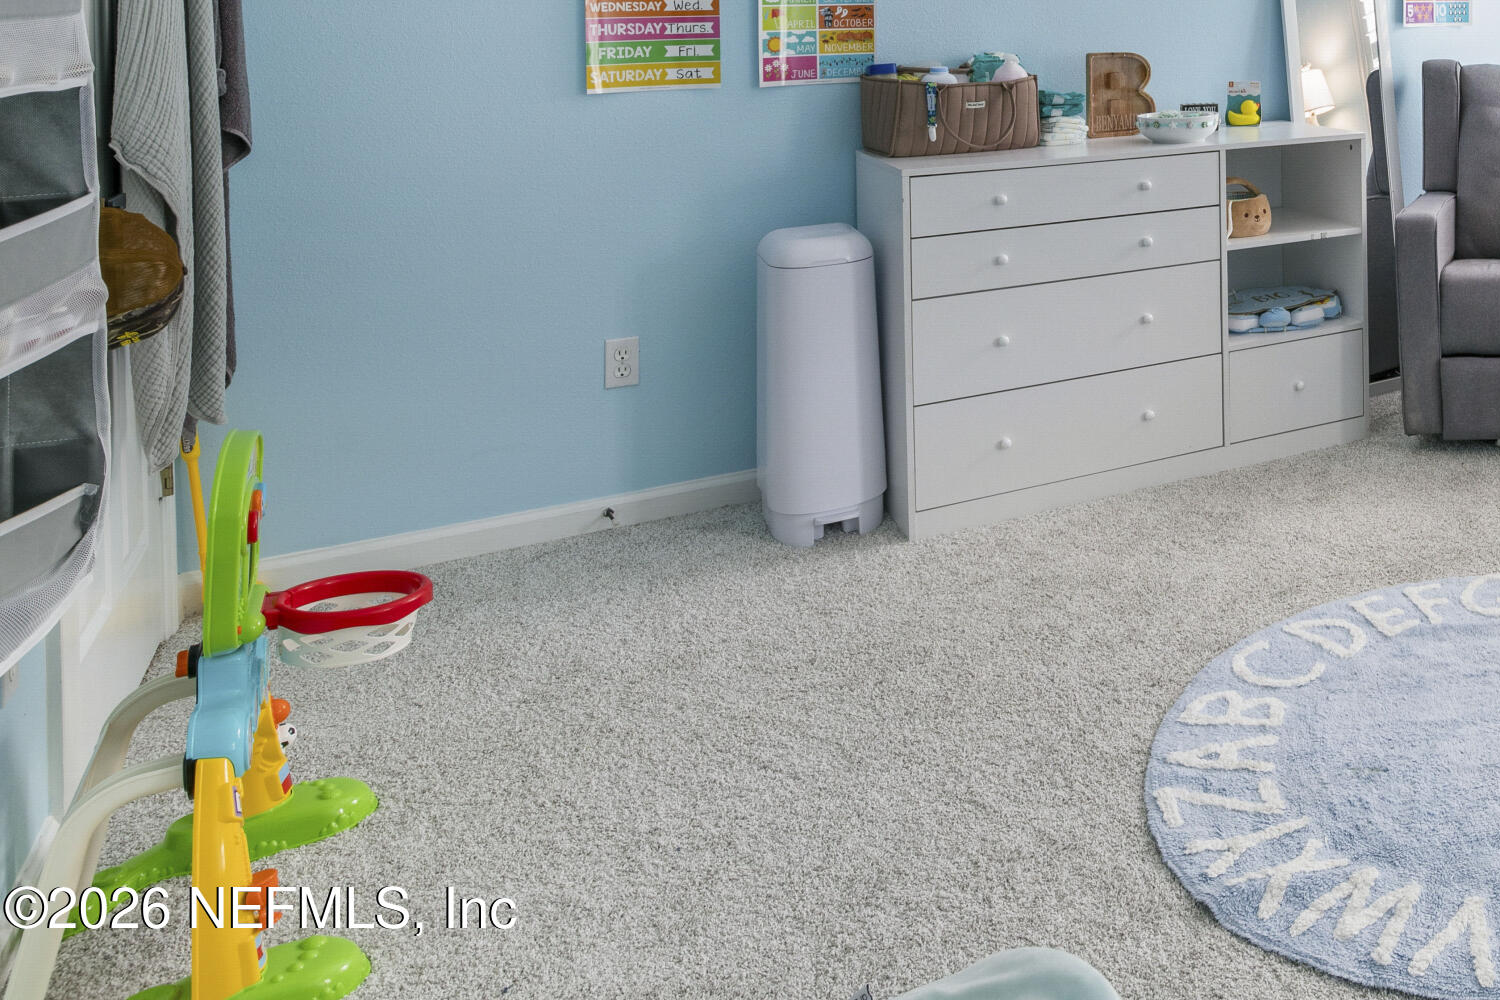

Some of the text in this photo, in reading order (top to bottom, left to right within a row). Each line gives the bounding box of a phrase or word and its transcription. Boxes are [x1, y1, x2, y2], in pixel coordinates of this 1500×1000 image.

[589, 0, 704, 13] WEDNESDAY Wed.
[1407, 4, 1414, 18] 5
[1436, 4, 1447, 17] 10
[788, 19, 816, 28] APRIL
[833, 18, 873, 27] OCTOBER
[589, 22, 710, 37] THURSDAY Thurs.
[598, 45, 653, 60] FRIDAY
[796, 44, 816, 53] MAY
[824, 42, 873, 52] NOVEMBER
[590, 68, 663, 84] SATURDAY
[790, 69, 816, 79] JUNE
[827, 67, 866, 77] DECEMB
[1096, 113, 1138, 131] BENYAMI
